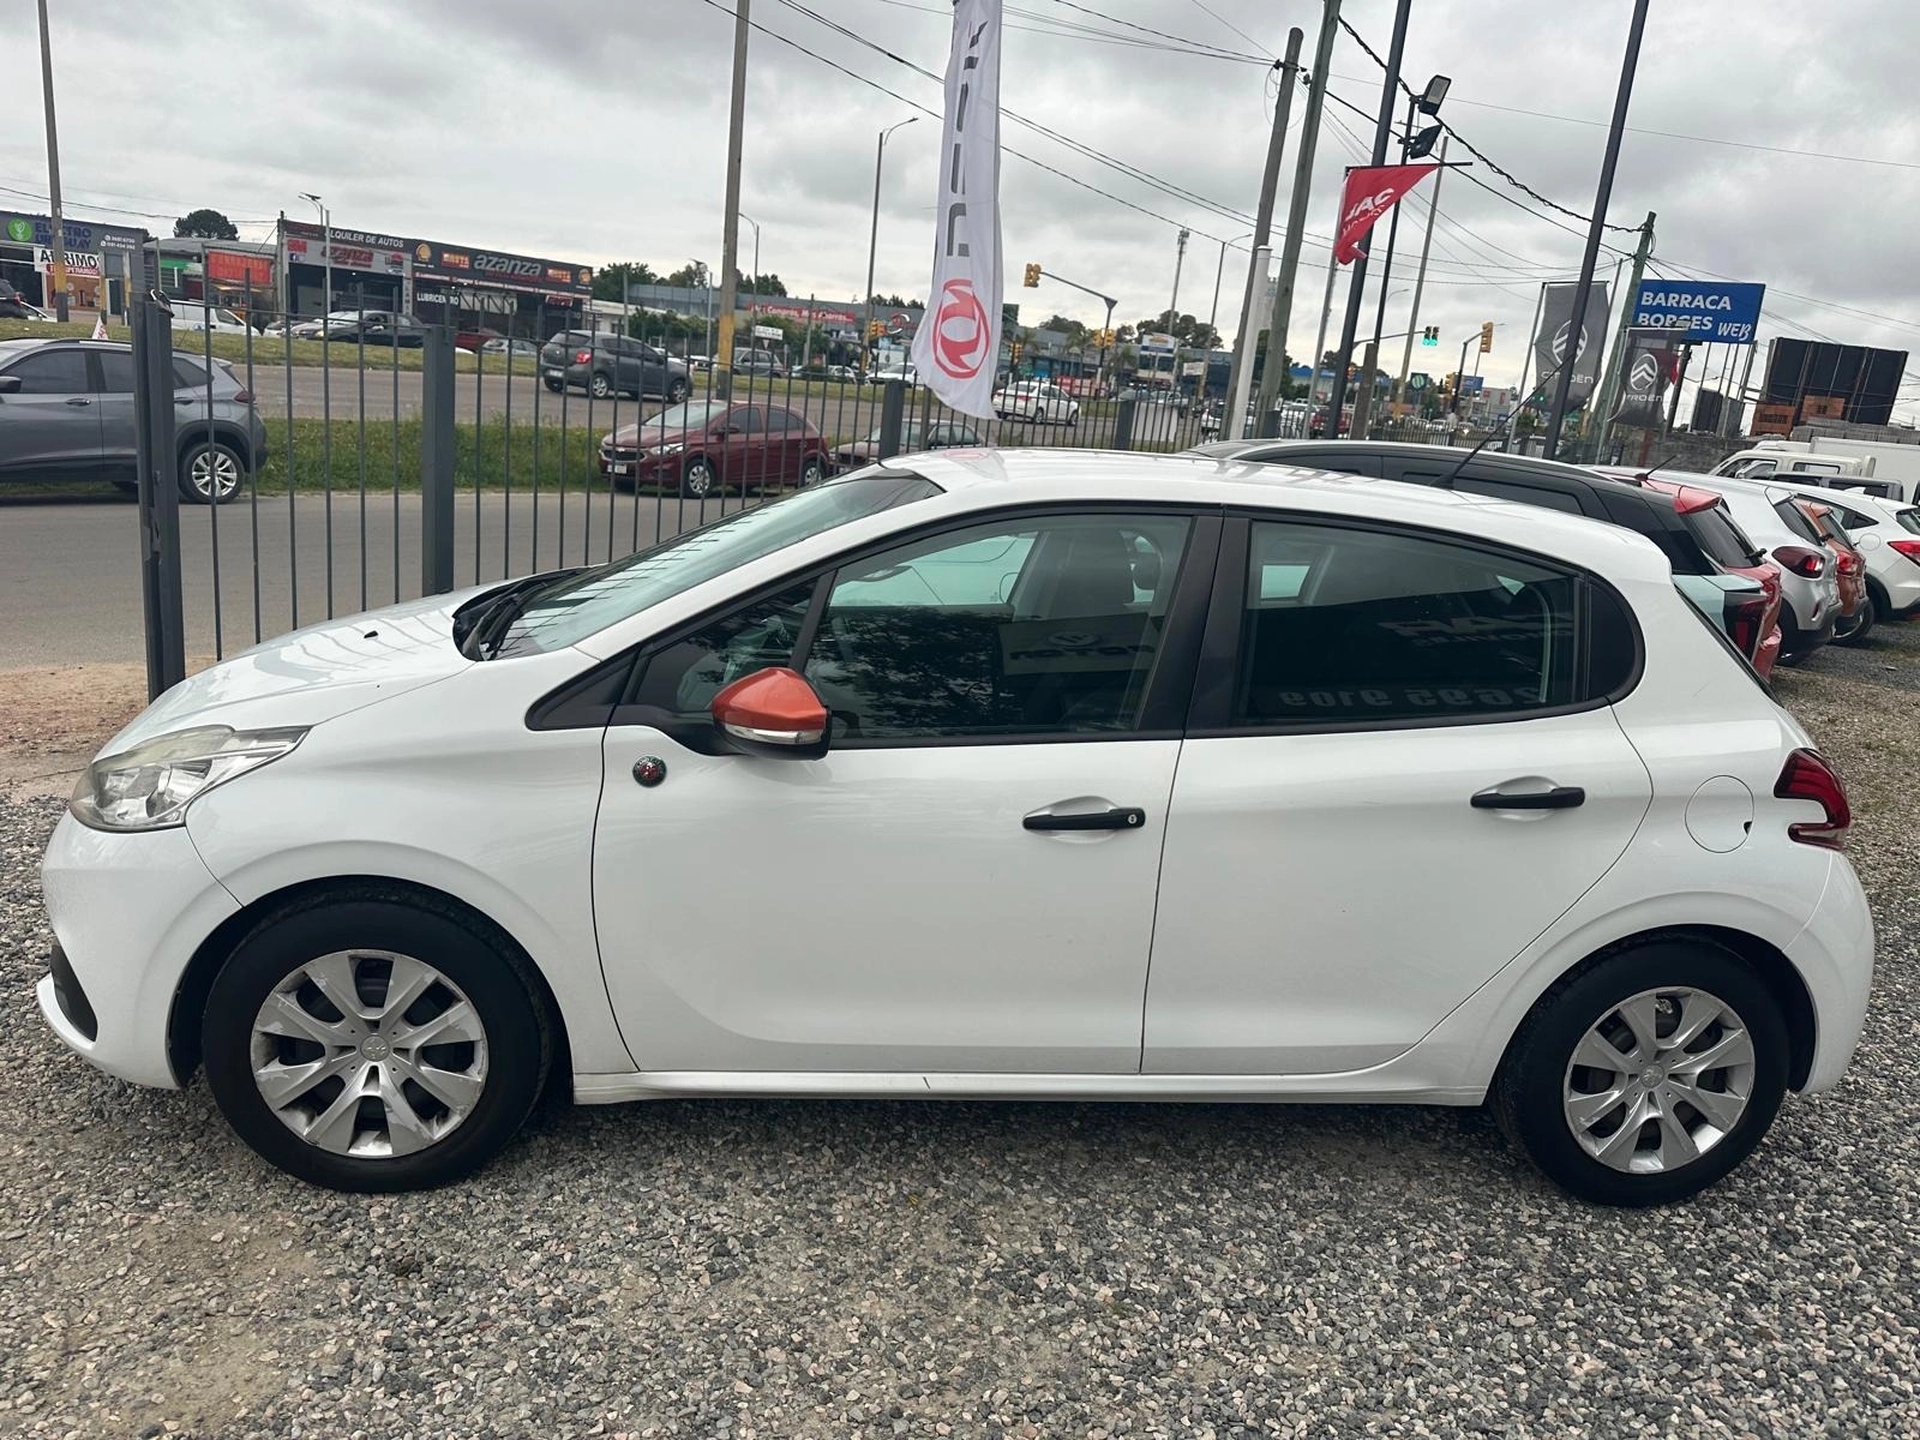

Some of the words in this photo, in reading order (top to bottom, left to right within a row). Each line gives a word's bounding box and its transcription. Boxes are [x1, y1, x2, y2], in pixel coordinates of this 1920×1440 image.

[365, 235, 377, 245] DE
[378, 236, 404, 248] AUTOS
[474, 254, 541, 276] azanza
[1641, 291, 1732, 311] BARRACA
